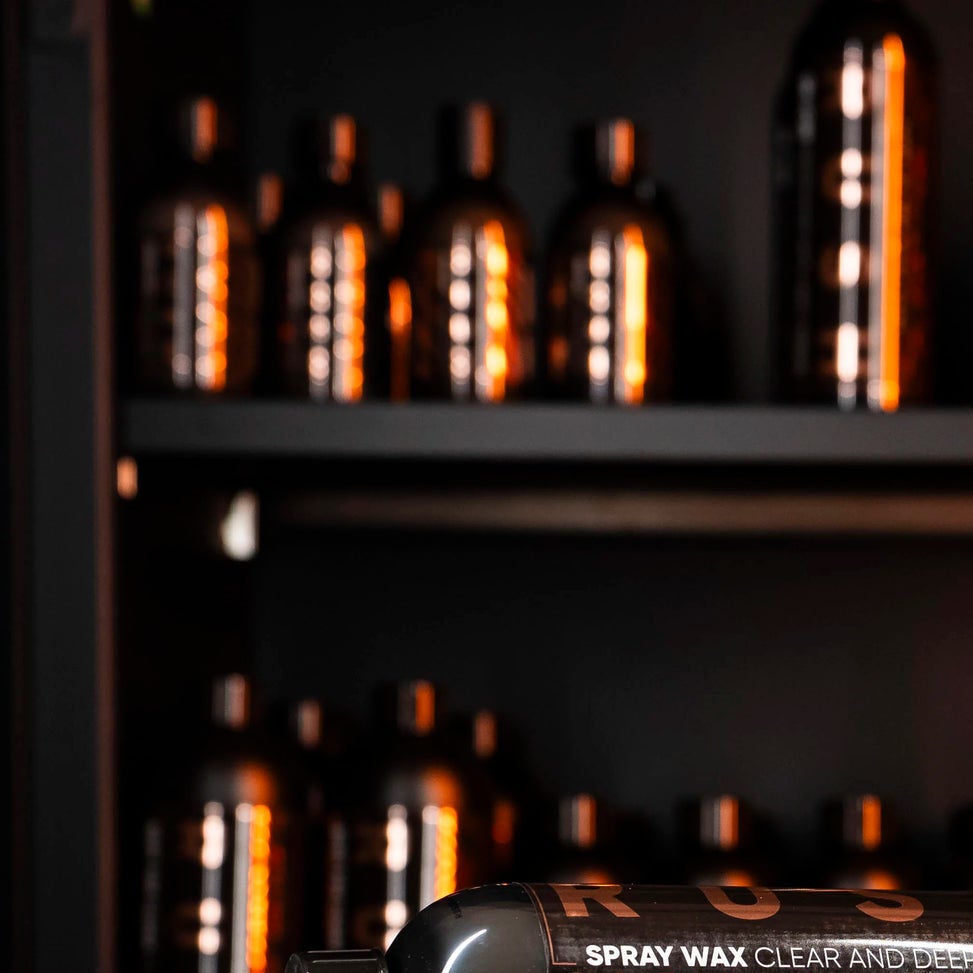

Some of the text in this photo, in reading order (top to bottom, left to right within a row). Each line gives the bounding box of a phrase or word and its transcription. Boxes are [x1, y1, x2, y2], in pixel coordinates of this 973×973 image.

[586, 944, 674, 967] SPRAY
[680, 946, 749, 967] WAX
[754, 946, 842, 968] CLEAR
[849, 947, 904, 969] AND
